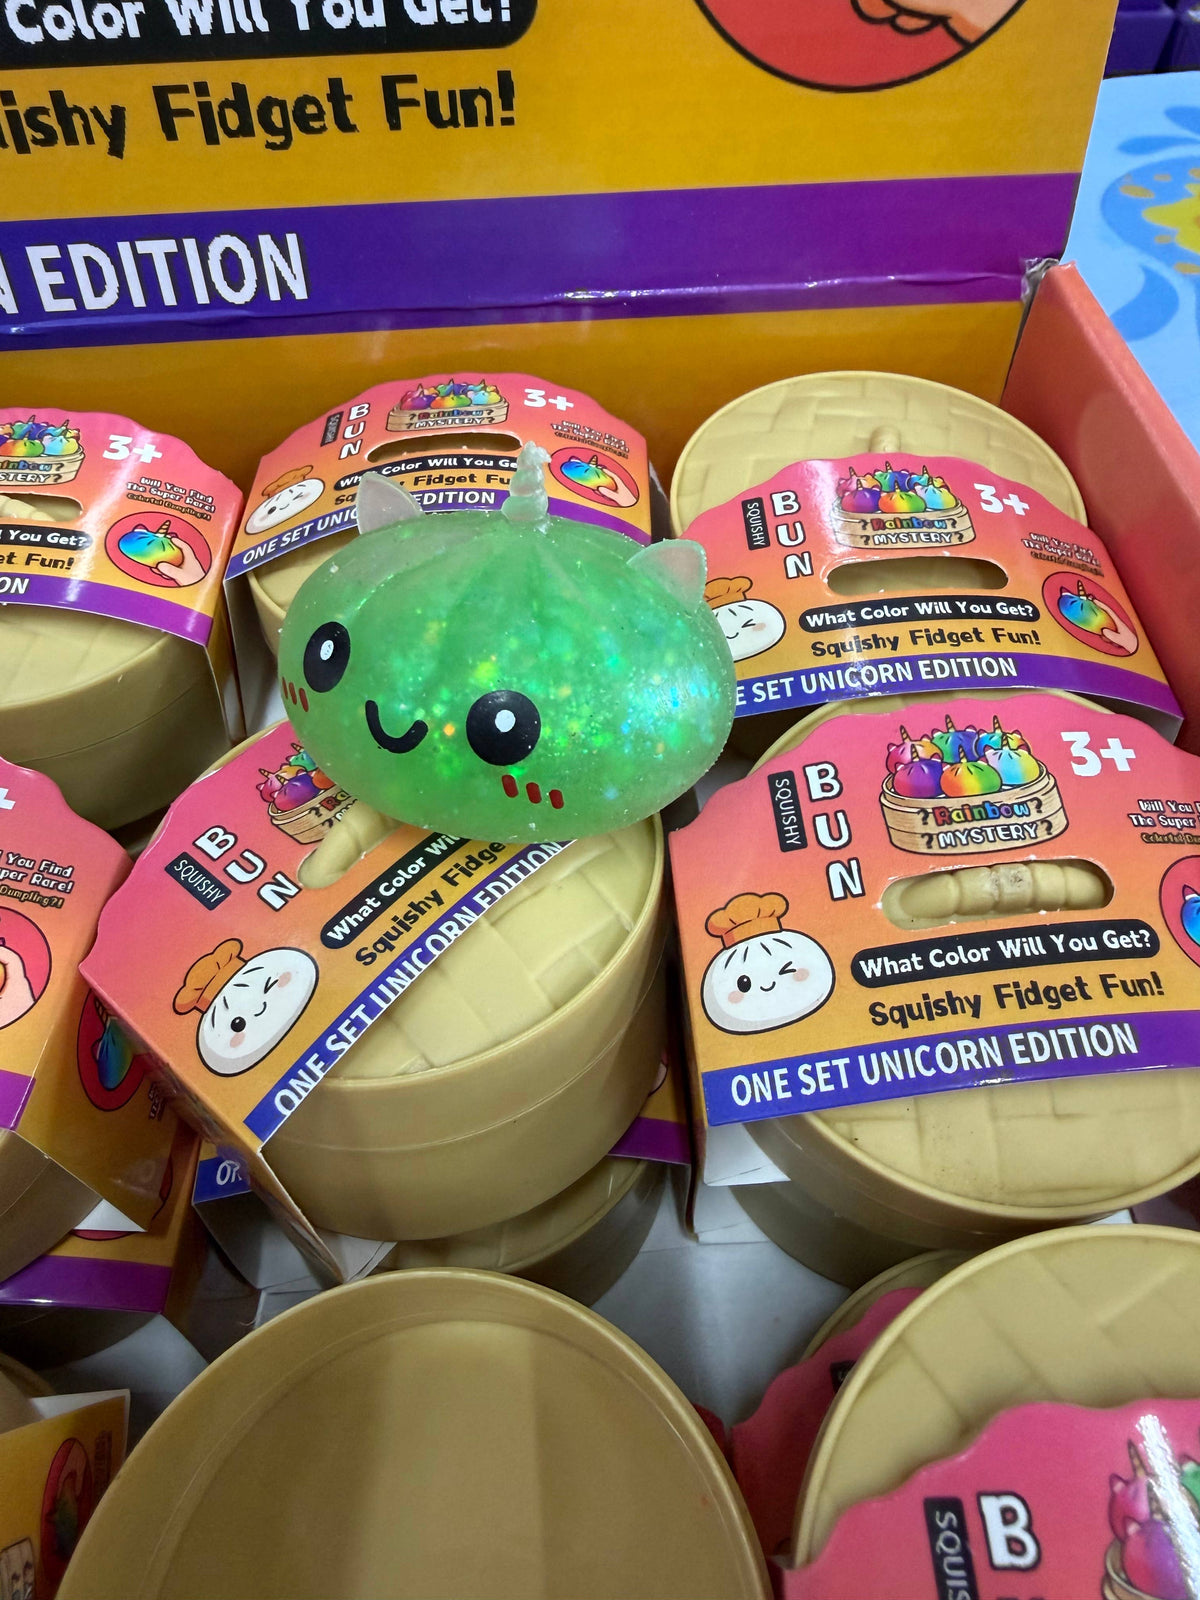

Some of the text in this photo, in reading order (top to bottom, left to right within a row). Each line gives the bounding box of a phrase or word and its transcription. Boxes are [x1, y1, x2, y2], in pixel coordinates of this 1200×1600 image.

[4, 0, 145, 44] Color
[165, 0, 269, 36] Will
[290, 0, 387, 32] You
[0, 70, 515, 159] ishy Fidget Fun!
[25, 233, 308, 312] EDITION
[524, 388, 574, 411] 3+
[102, 434, 163, 464] 3+
[0, 460, 52, 472] inbow
[382, 461, 423, 475] Color
[428, 457, 458, 467] Will
[463, 457, 494, 467] You
[499, 459, 518, 468] Ge
[413, 473, 511, 486] Fidget Fu
[127, 482, 147, 492] The
[140, 477, 162, 488] Will
[165, 482, 186, 494] You
[973, 483, 1030, 516] 3+
[9, 529, 88, 546] You Get?
[242, 490, 495, 565] ONE SET UNIC EDITION
[747, 502, 766, 546] SQUISHY
[870, 516, 948, 531] Rainbow
[873, 531, 953, 545] MYSTERY
[25, 552, 75, 570] Fun!
[805, 601, 1034, 628] What Color Will You Get?
[811, 627, 1041, 658] Squishy Fidget Fun!
[751, 677, 794, 703] SET
[801, 661, 914, 694] UNICORN
[917, 657, 1018, 680] EDITION
[1061, 731, 1136, 777] 3+
[775, 778, 802, 845] SQUISHY
[932, 801, 1030, 826] Rainbow
[1138, 799, 1165, 813] Will
[1166, 800, 1195, 814] You
[938, 822, 1038, 849] MYSTERY
[1127, 813, 1196, 831] The Super
[6, 852, 75, 878] You Find
[0, 867, 75, 894] per Rare!
[173, 859, 225, 904] SQUISHY
[327, 833, 462, 942] What Color Wil
[355, 841, 507, 967] Squishy Fidge
[860, 929, 1151, 979] What Color Will You Get?
[274, 841, 564, 1117] ONE SET UNICORN EDITION
[868, 971, 1165, 1028] Squishy Fidget Fun!
[731, 1022, 1139, 1107] ONE SET UNICORN EDITION
